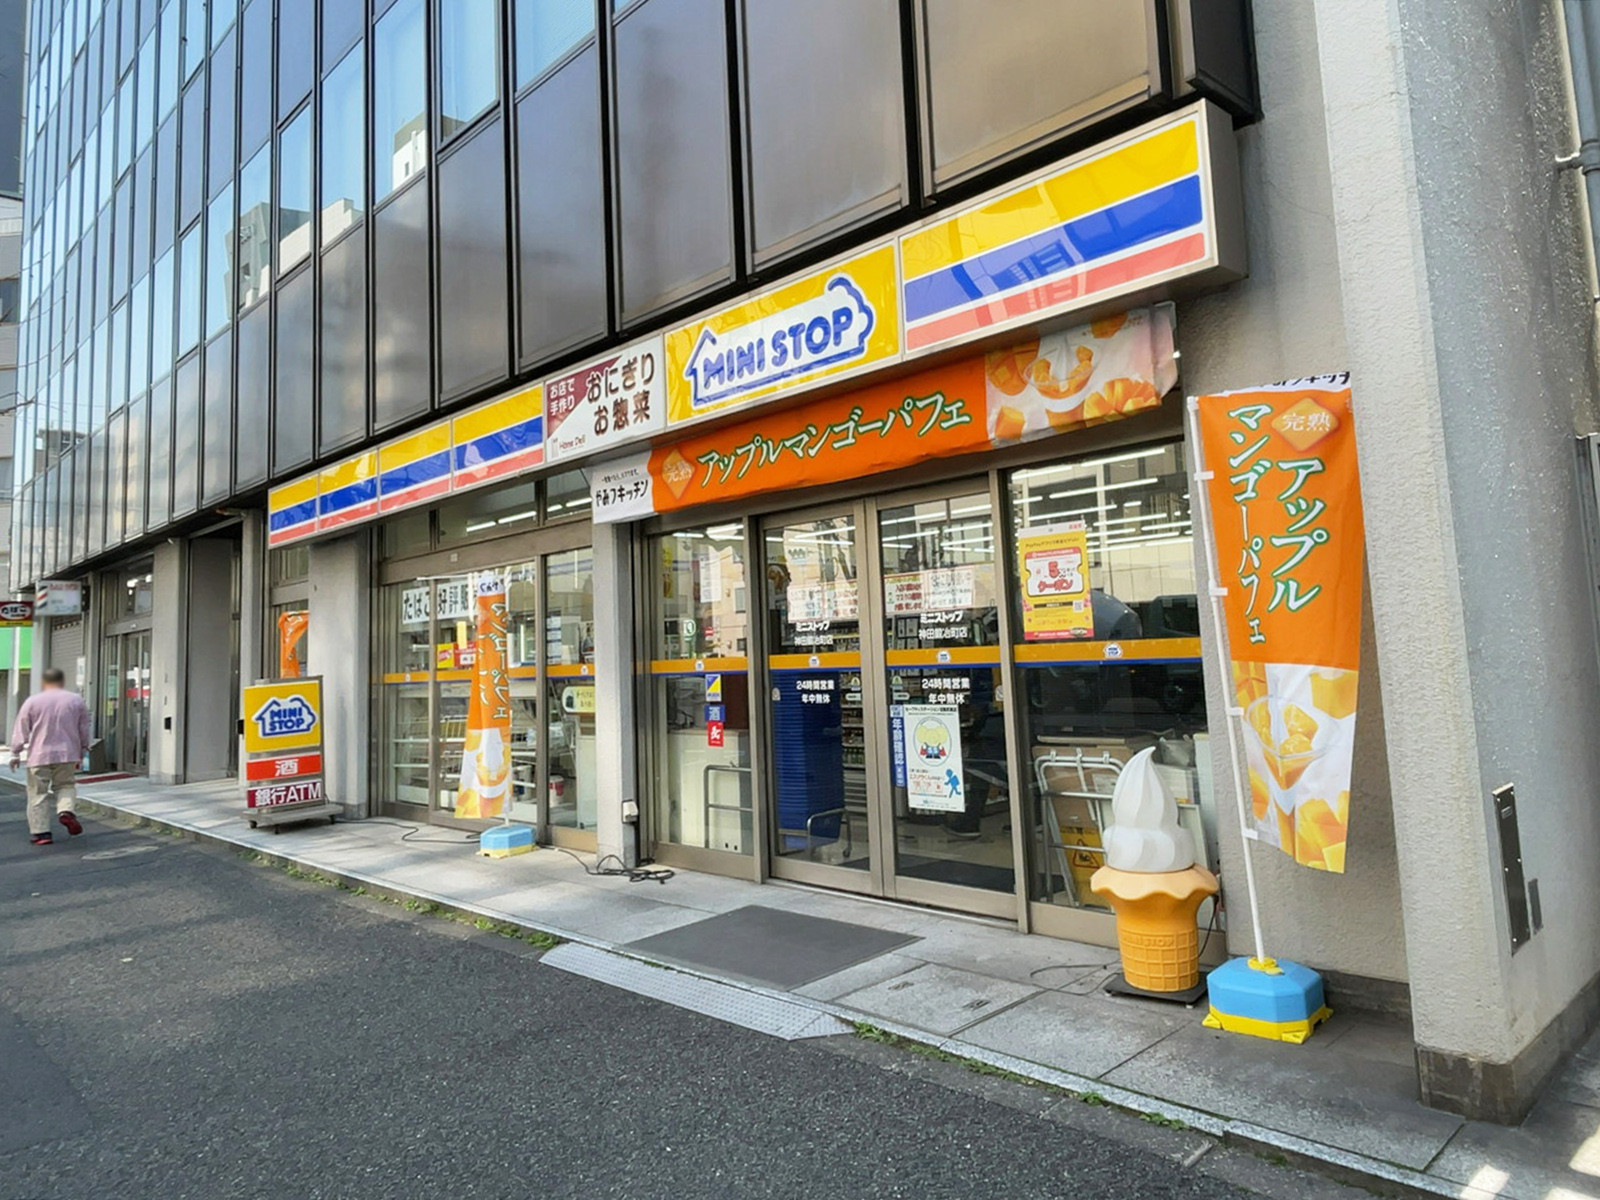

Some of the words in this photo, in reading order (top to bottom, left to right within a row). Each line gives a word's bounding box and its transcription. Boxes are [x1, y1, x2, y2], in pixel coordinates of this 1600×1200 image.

[703, 338, 765, 390] MINI
[771, 306, 854, 367] STOP
[550, 378, 576, 399] お店で
[587, 352, 655, 404] おにぎり
[550, 395, 575, 416] 手作り
[594, 389, 650, 436] お惣菜
[1281, 412, 1331, 433] 完熟
[697, 392, 972, 488] アップルマンゴーパフェ
[595, 479, 649, 507] やみつキッチン
[1228, 403, 1273, 644] マンゴーパフェ
[1267, 457, 1329, 613] アップル
[796, 620, 830, 632] ミニストップ
[920, 610, 963, 623] ミニストップ
[796, 679, 835, 691] 24時間営業
[921, 677, 970, 689] 24時間営業
[801, 693, 831, 705] 年中無休
[928, 693, 965, 705] 年中無休
[270, 706, 303, 721] MINI
[269, 717, 305, 733] STOP
[275, 758, 299, 777] 酒
[255, 781, 322, 807] 銀行ATM
